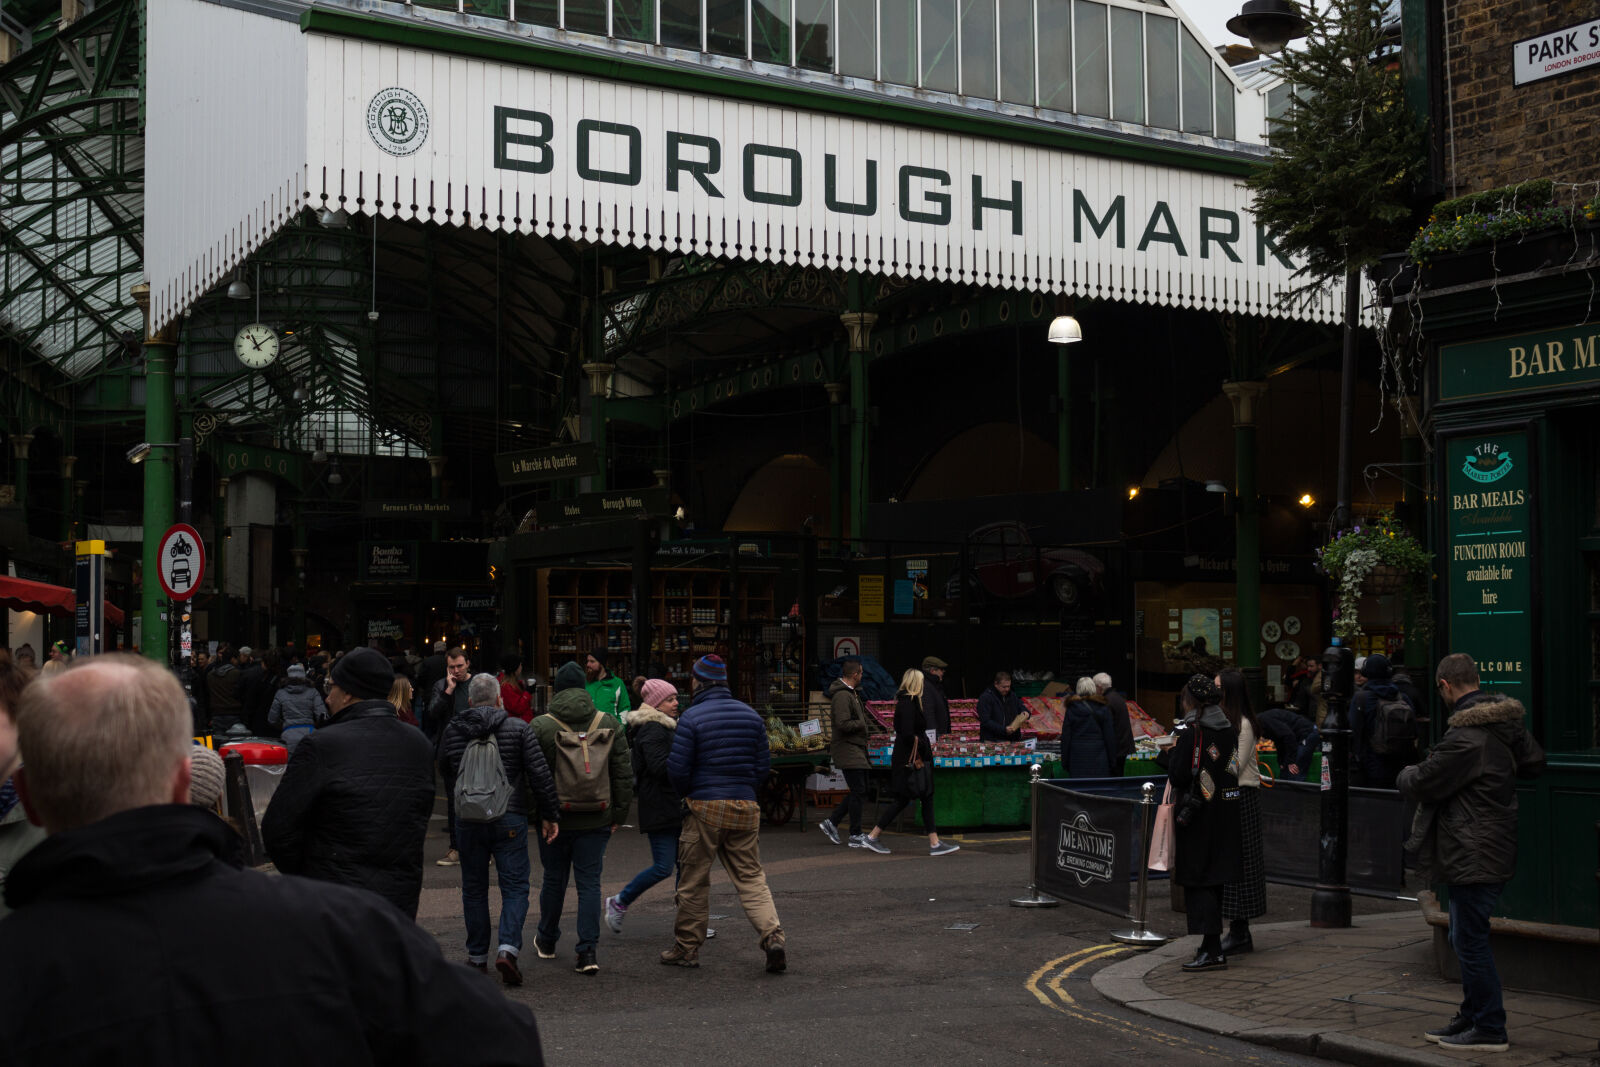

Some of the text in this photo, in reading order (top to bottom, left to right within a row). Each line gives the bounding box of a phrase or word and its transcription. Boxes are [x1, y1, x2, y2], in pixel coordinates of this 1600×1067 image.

[1528, 25, 1600, 65] PARK S
[1544, 59, 1572, 72] LONDON
[370, 91, 426, 136] BOROUGH MARKET
[388, 144, 408, 152] 1756
[493, 105, 1346, 277] BOROUGH MARK
[1508, 335, 1600, 379] BAR M
[1474, 442, 1500, 456] THE
[552, 453, 577, 471] Quartier
[602, 497, 625, 510] Borough
[1453, 489, 1526, 510] BAR MEALS
[1453, 541, 1526, 561] FUNCTION ROOM
[1466, 564, 1513, 582] available for
[1481, 588, 1499, 605] hire
[1473, 661, 1523, 672] LCOME
[1062, 828, 1113, 858] MEANTIME
[1085, 860, 1106, 872] COMPANY
